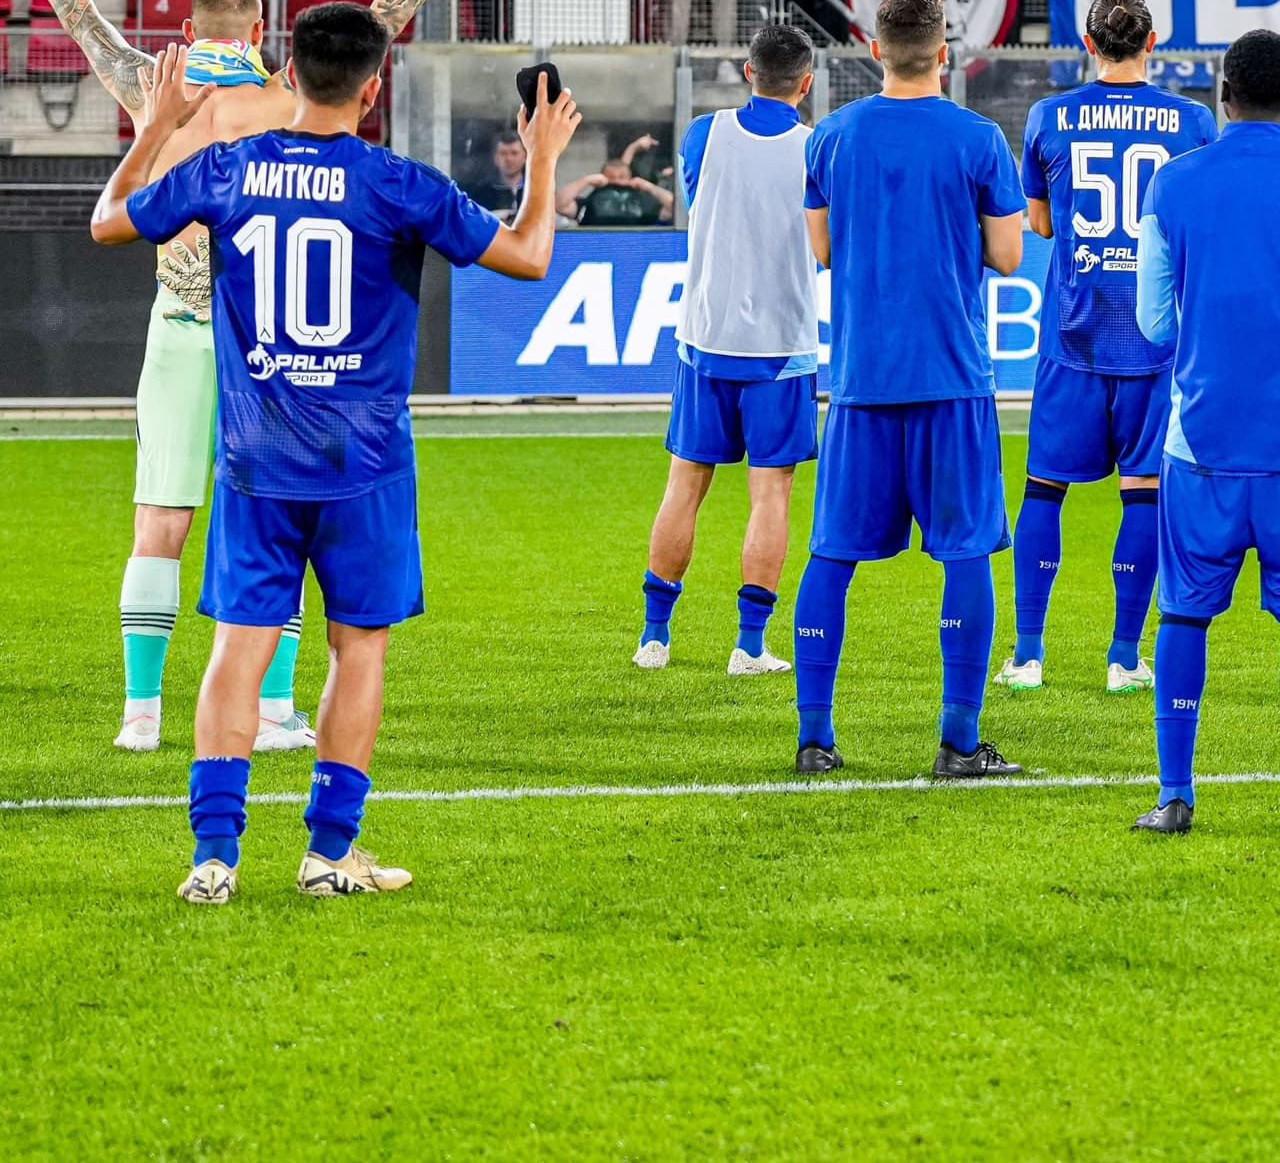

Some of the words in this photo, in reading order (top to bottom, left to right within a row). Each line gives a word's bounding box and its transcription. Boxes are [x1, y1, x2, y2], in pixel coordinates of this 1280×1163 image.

[1056, 106, 1073, 131] К.
[1077, 104, 1181, 134] ДИМИТРОВ
[242, 161, 345, 202] МИТКОВ
[1071, 141, 1171, 239] 50
[1102, 247, 1138, 260] PAL
[232, 214, 352, 347] 10
[275, 353, 362, 371] PALMS
[797, 626, 825, 638] 1914
[1172, 698, 1197, 710] 1914
